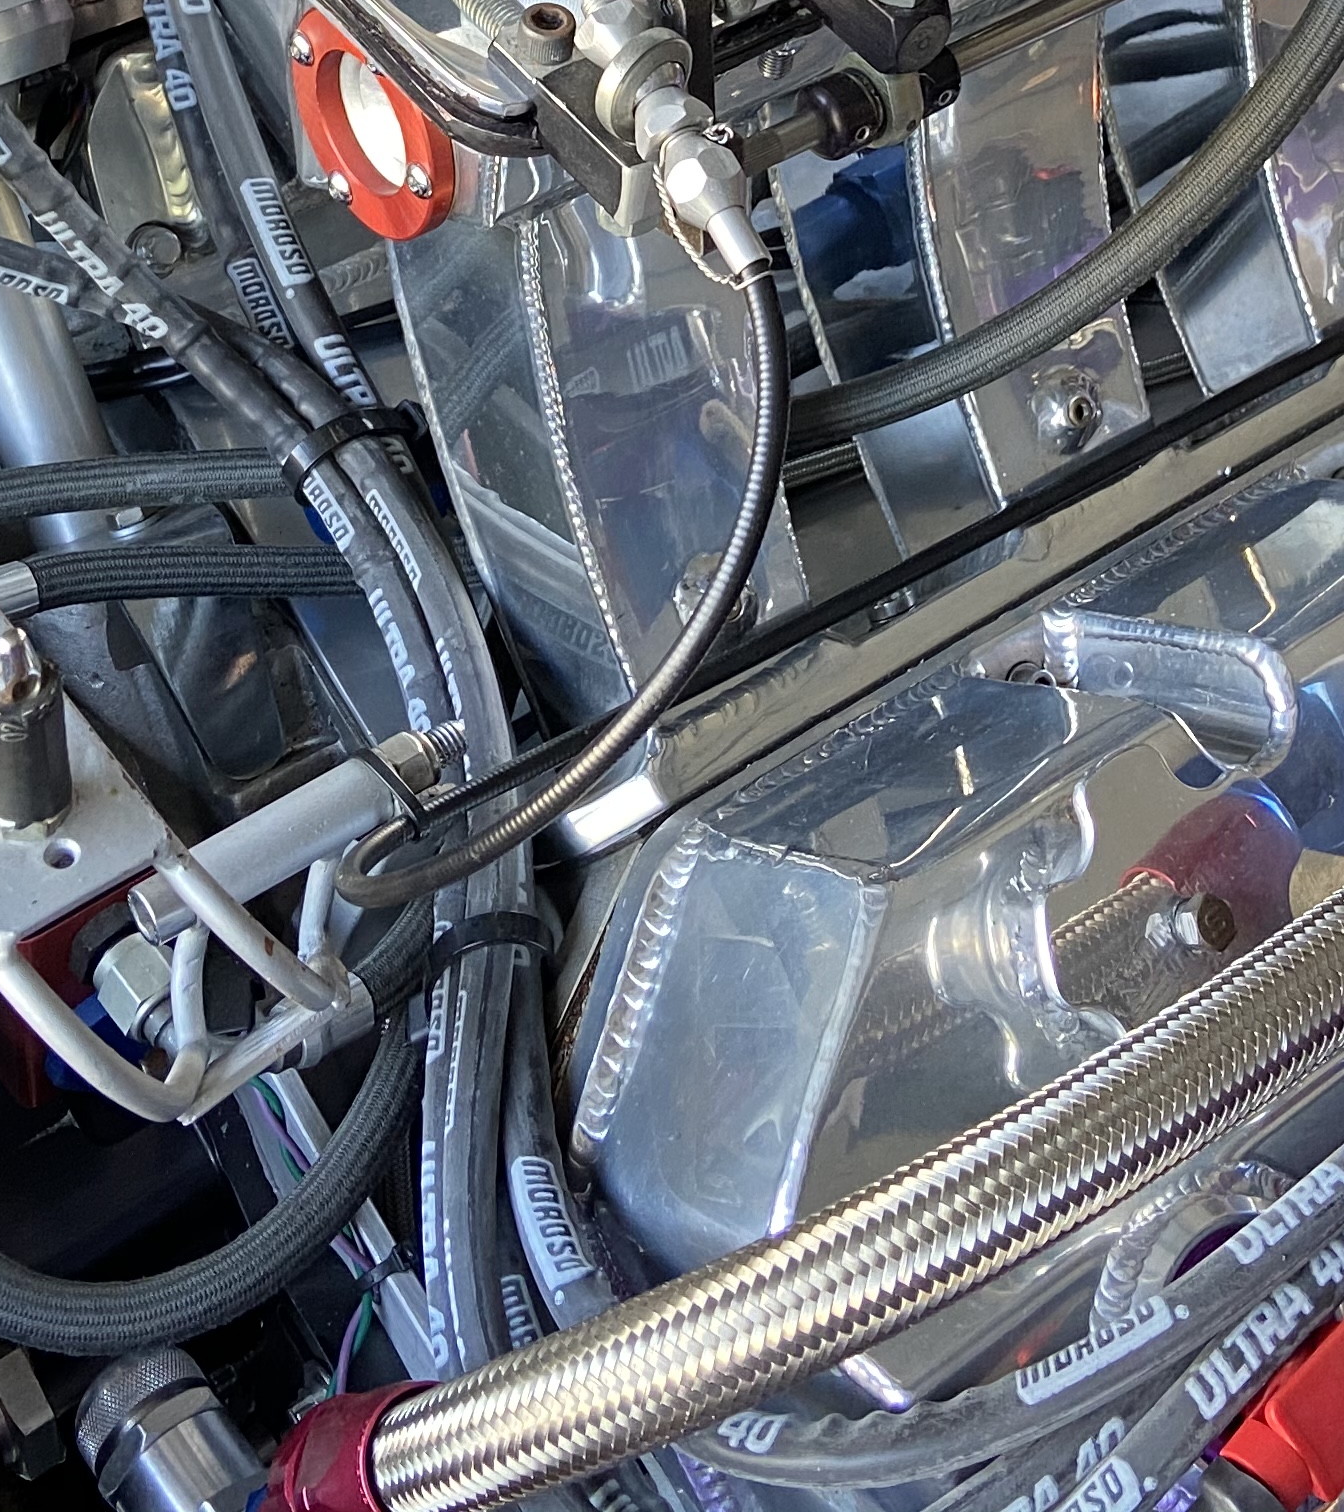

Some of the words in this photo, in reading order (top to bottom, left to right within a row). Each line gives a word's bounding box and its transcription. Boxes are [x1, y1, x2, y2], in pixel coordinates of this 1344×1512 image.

[164, 67, 198, 112] 40
[120, 302, 170, 340] 40
[239, 176, 317, 288] MOROSO
[313, 333, 378, 409] ULTR
[303, 469, 356, 552] OROSO
[510, 1154, 595, 1292] MOROSO
[1014, 1294, 1176, 1406] MOROSO
[1184, 1281, 1316, 1421] ULTRA
[716, 1410, 790, 1455] 40
